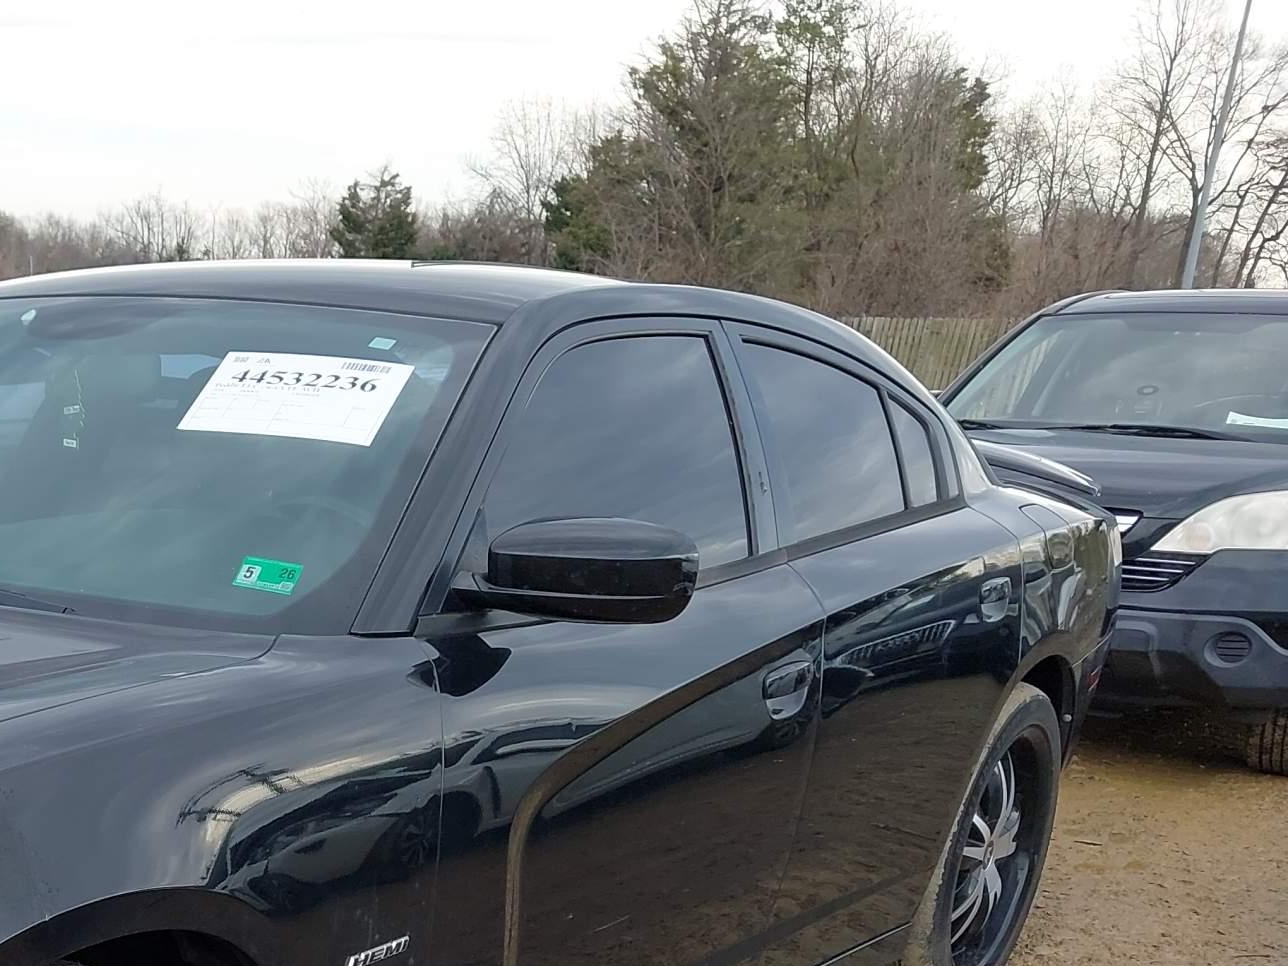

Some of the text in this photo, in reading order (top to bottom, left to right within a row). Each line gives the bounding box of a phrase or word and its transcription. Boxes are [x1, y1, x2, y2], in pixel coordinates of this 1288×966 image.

[231, 369, 380, 393] 44532236
[243, 566, 297, 580] 5 26
